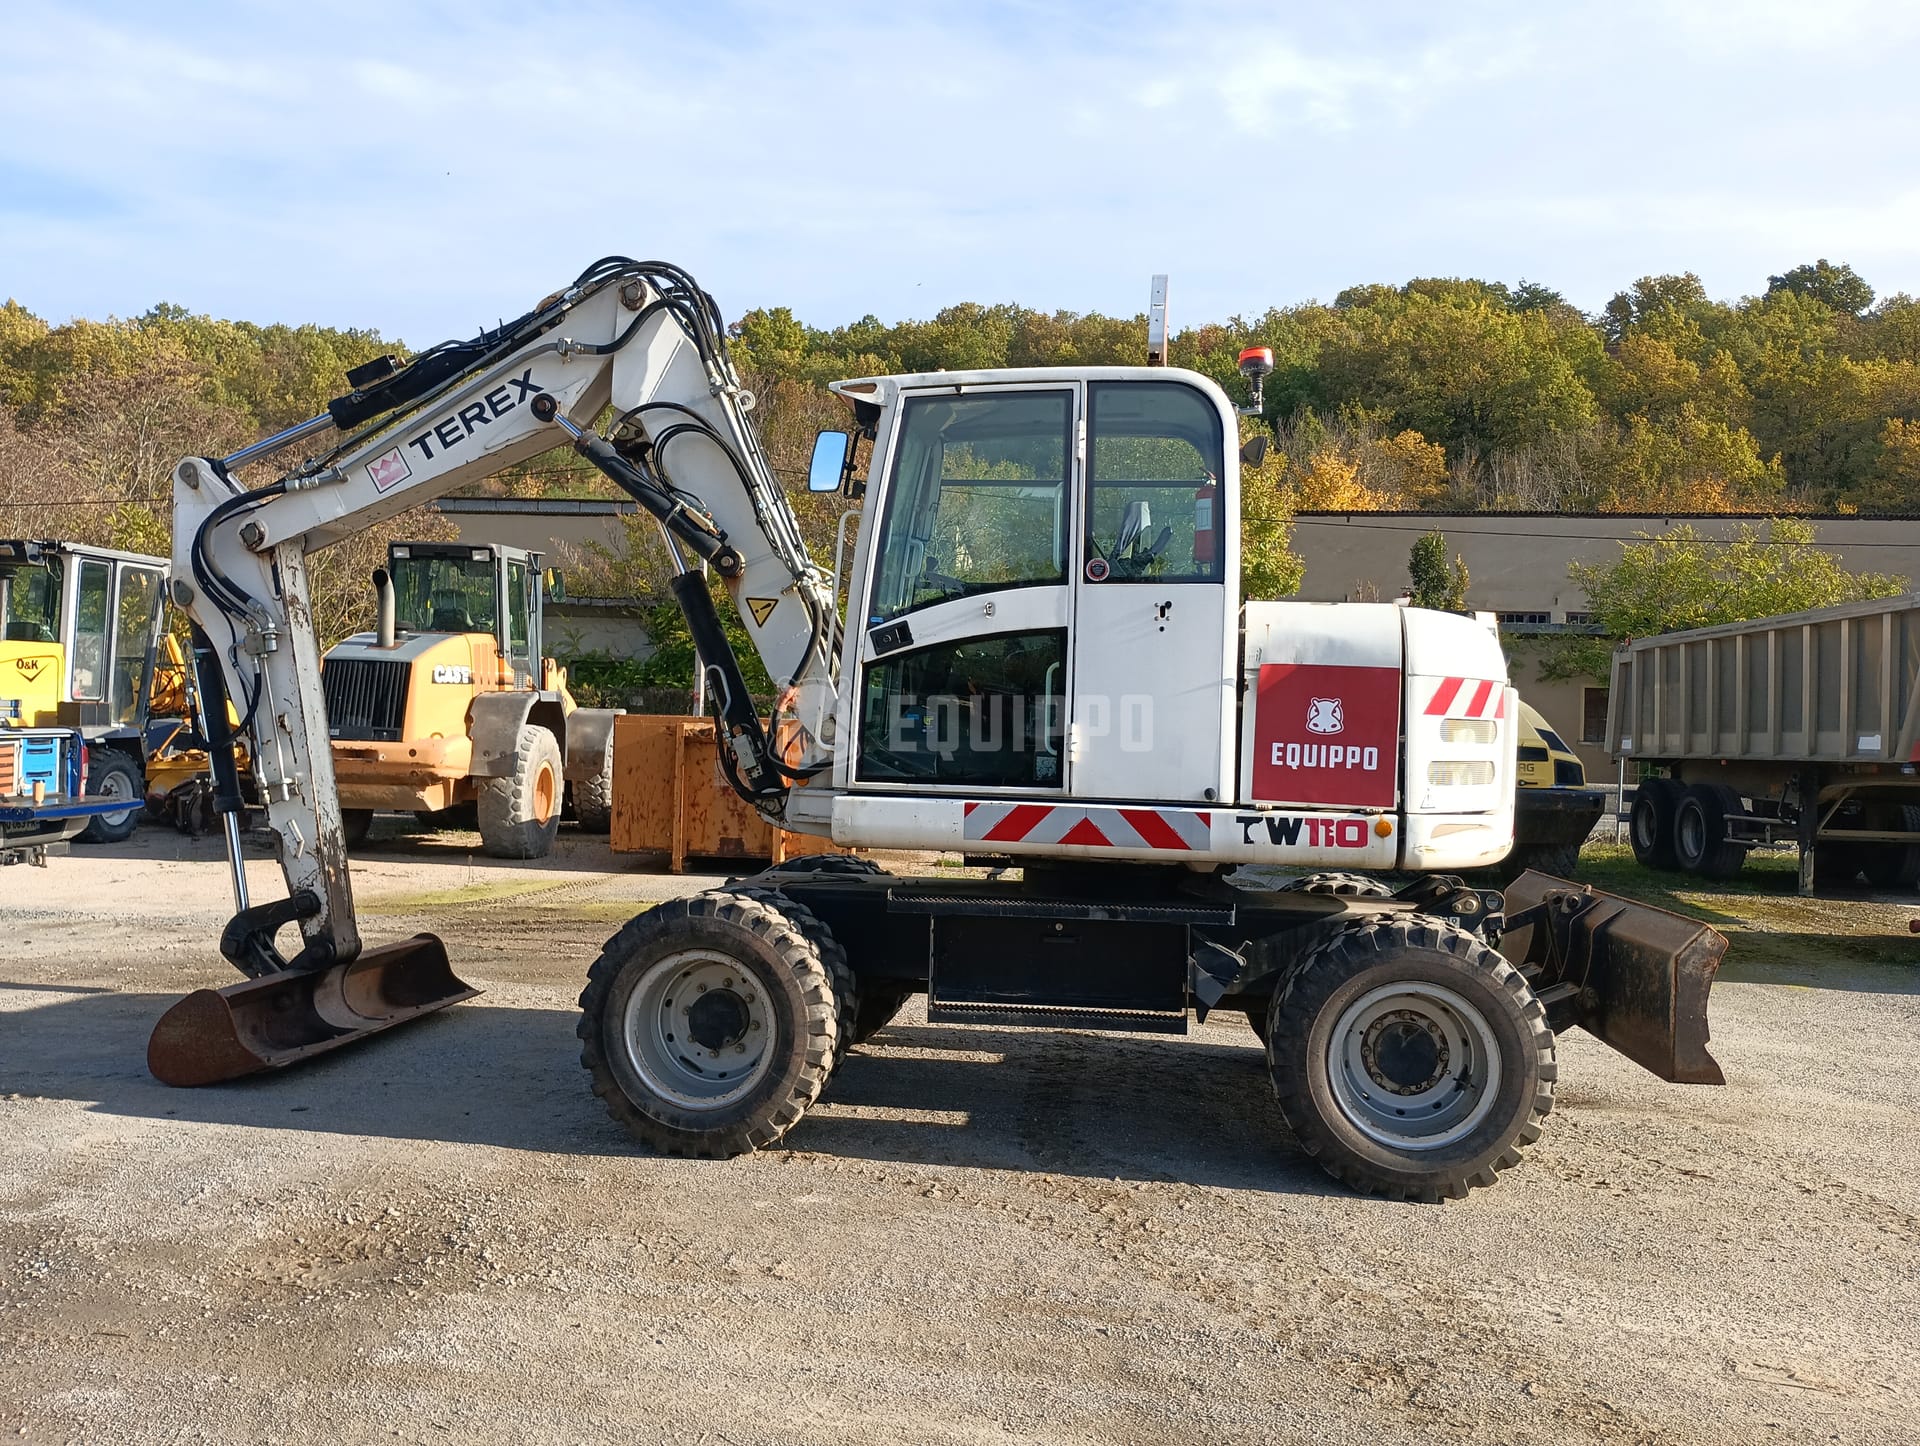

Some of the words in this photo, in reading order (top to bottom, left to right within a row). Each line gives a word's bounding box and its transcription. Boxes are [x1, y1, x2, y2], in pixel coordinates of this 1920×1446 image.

[408, 367, 544, 460] TEREX
[16, 658, 38, 670] O&K
[433, 664, 471, 684] CASE
[1271, 742, 1379, 771] EQUIPPO
